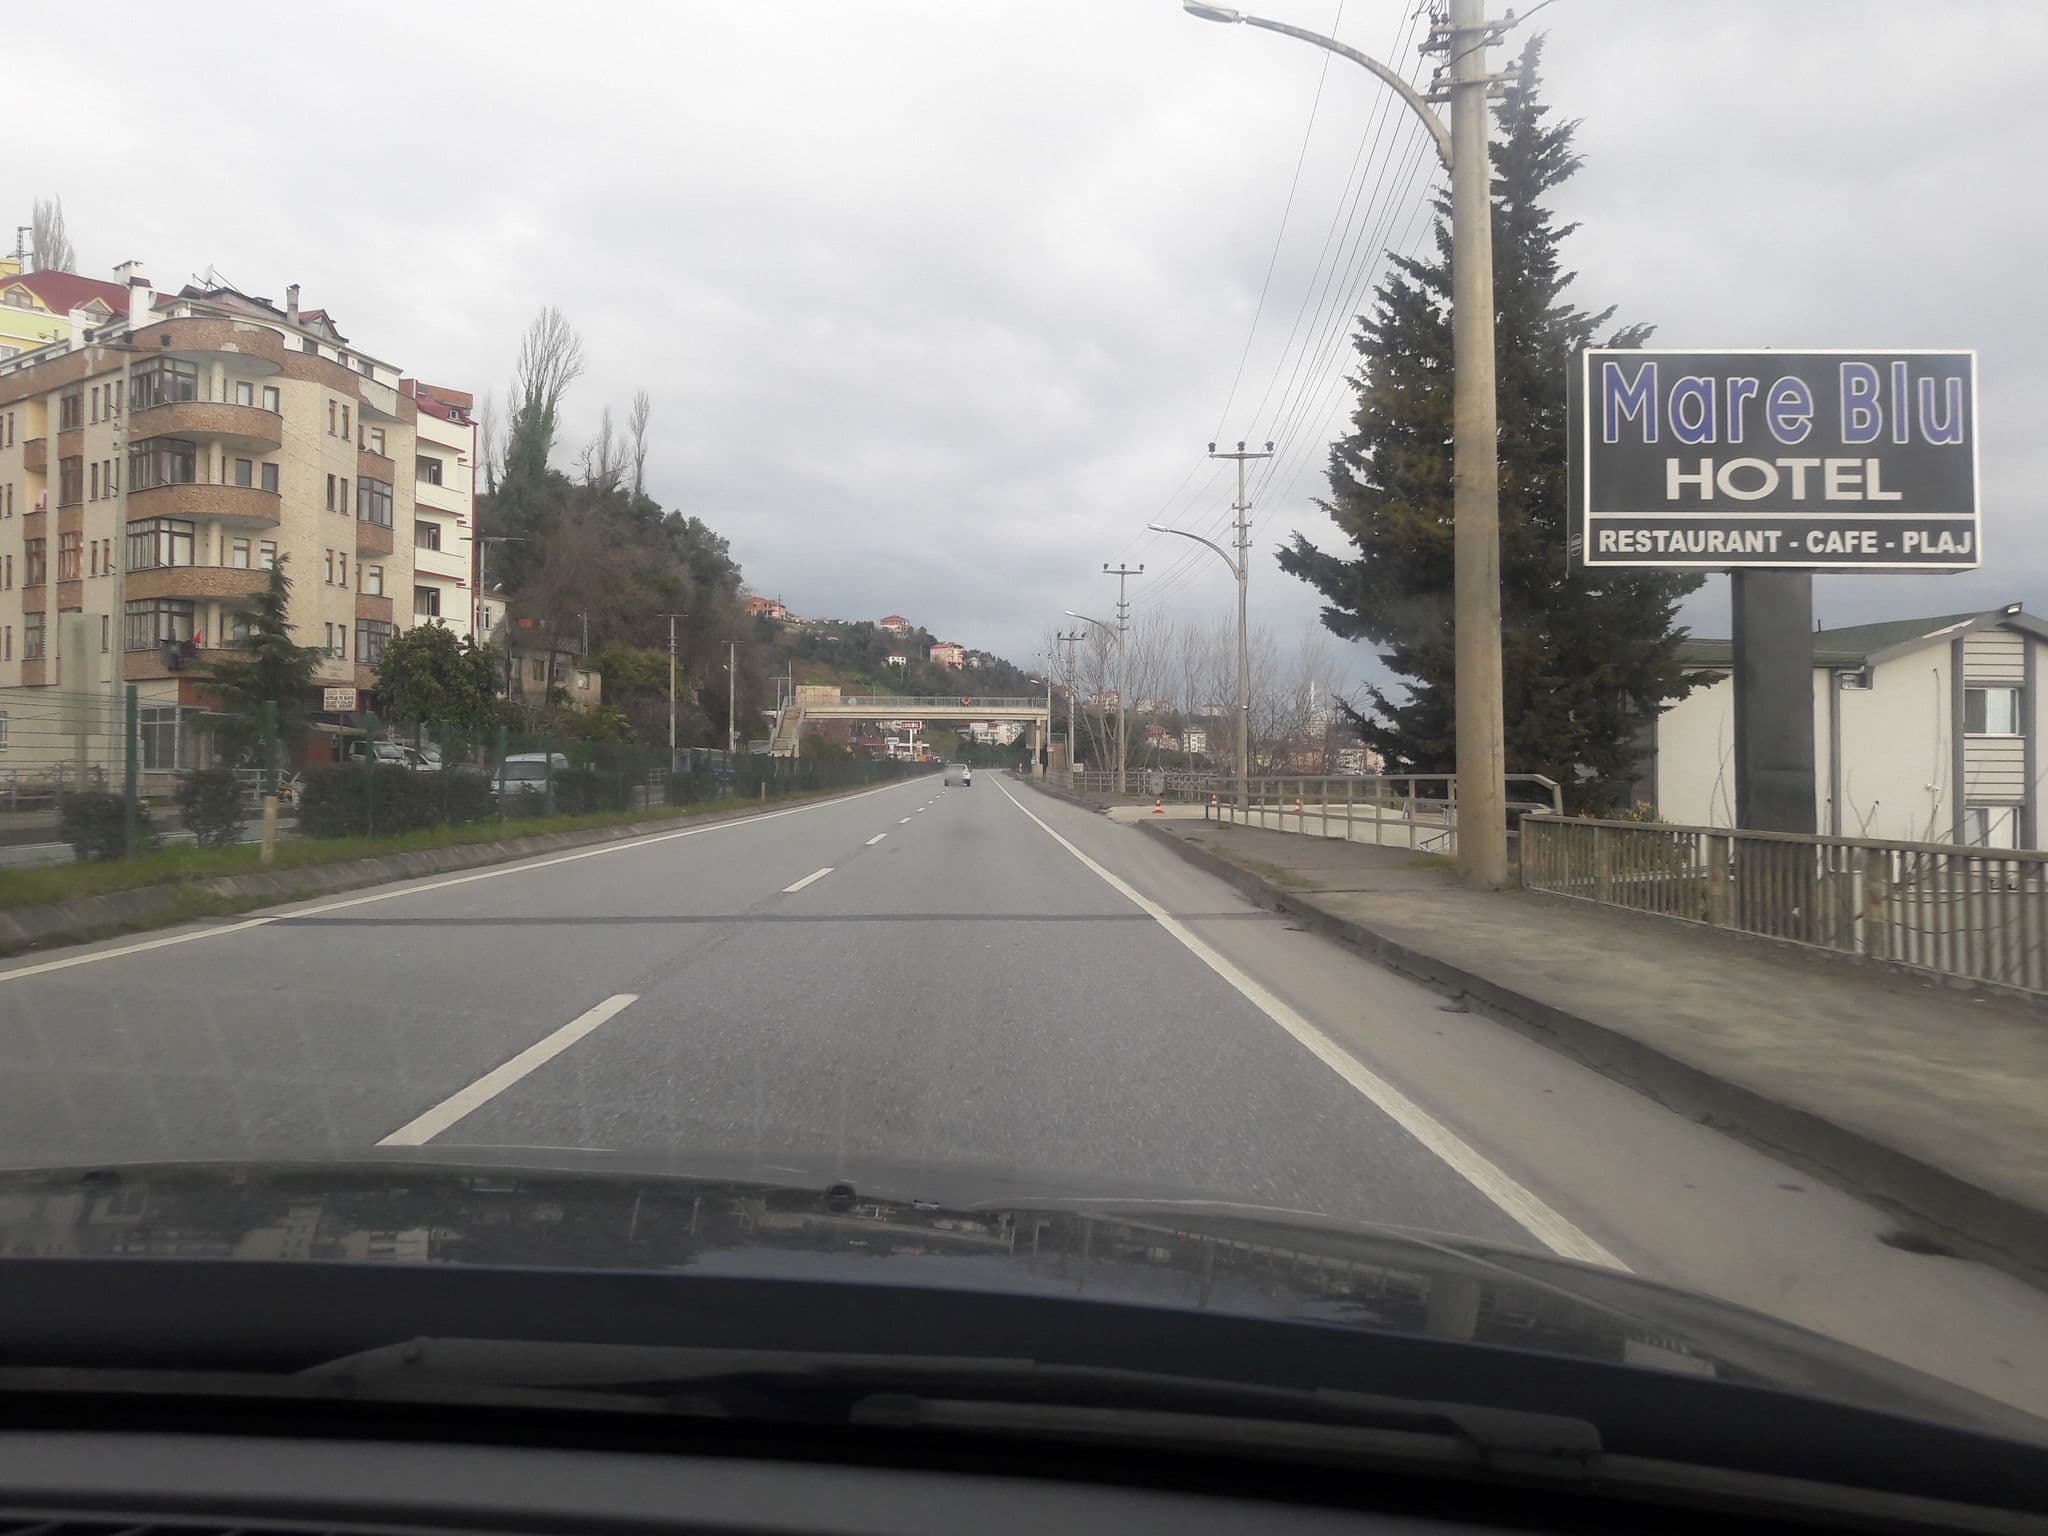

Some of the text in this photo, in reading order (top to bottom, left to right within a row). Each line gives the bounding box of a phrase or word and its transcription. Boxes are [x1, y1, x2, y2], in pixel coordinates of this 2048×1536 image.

[1602, 361, 1964, 445] Mare Blu
[1665, 457, 1902, 501] HOTEL
[1599, 529, 1783, 554] RESTAURANT
[1805, 529, 1878, 554] CAFE
[1902, 530, 1972, 555] PLAJ
